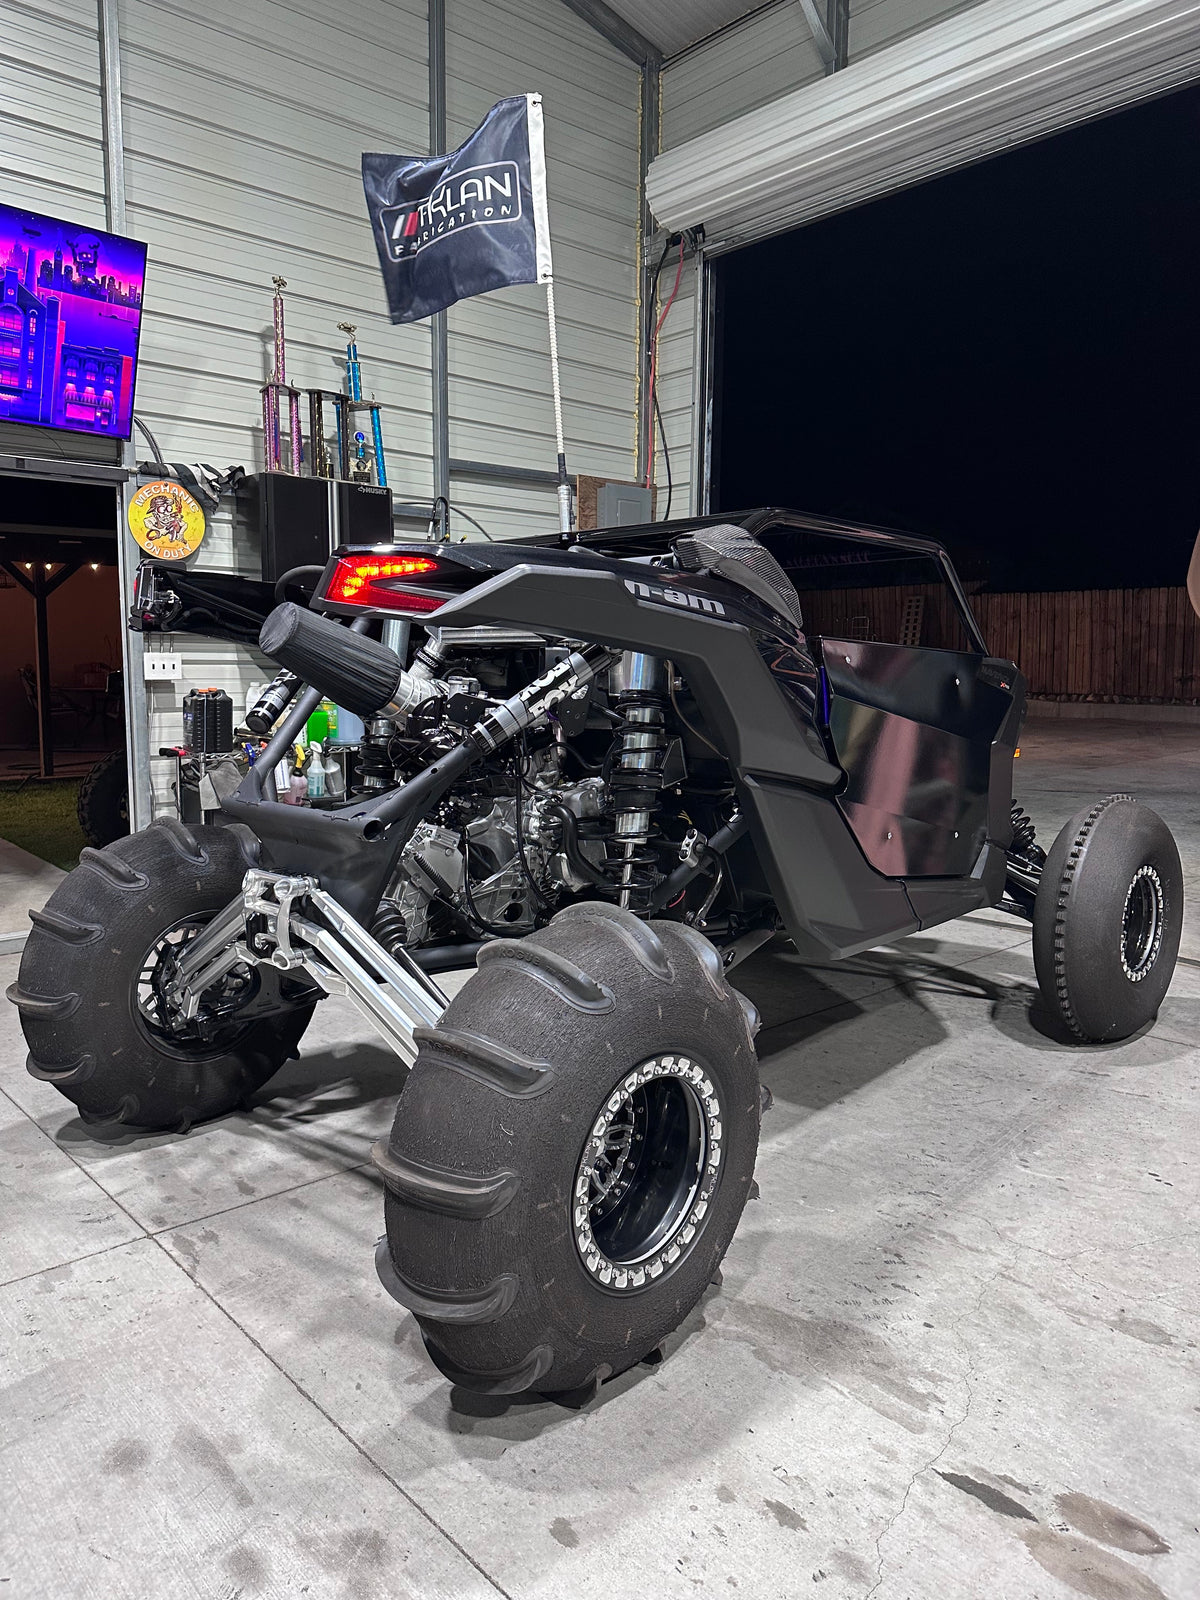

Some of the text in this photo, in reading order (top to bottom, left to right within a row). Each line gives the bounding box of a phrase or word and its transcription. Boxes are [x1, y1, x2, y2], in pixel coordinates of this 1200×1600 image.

[135, 484, 200, 513] MECHANIC
[365, 487, 387, 495] HUSKY
[144, 541, 192, 558] ON DUTY
[528, 674, 579, 719] FOX
[499, 947, 541, 967] ROGUE
